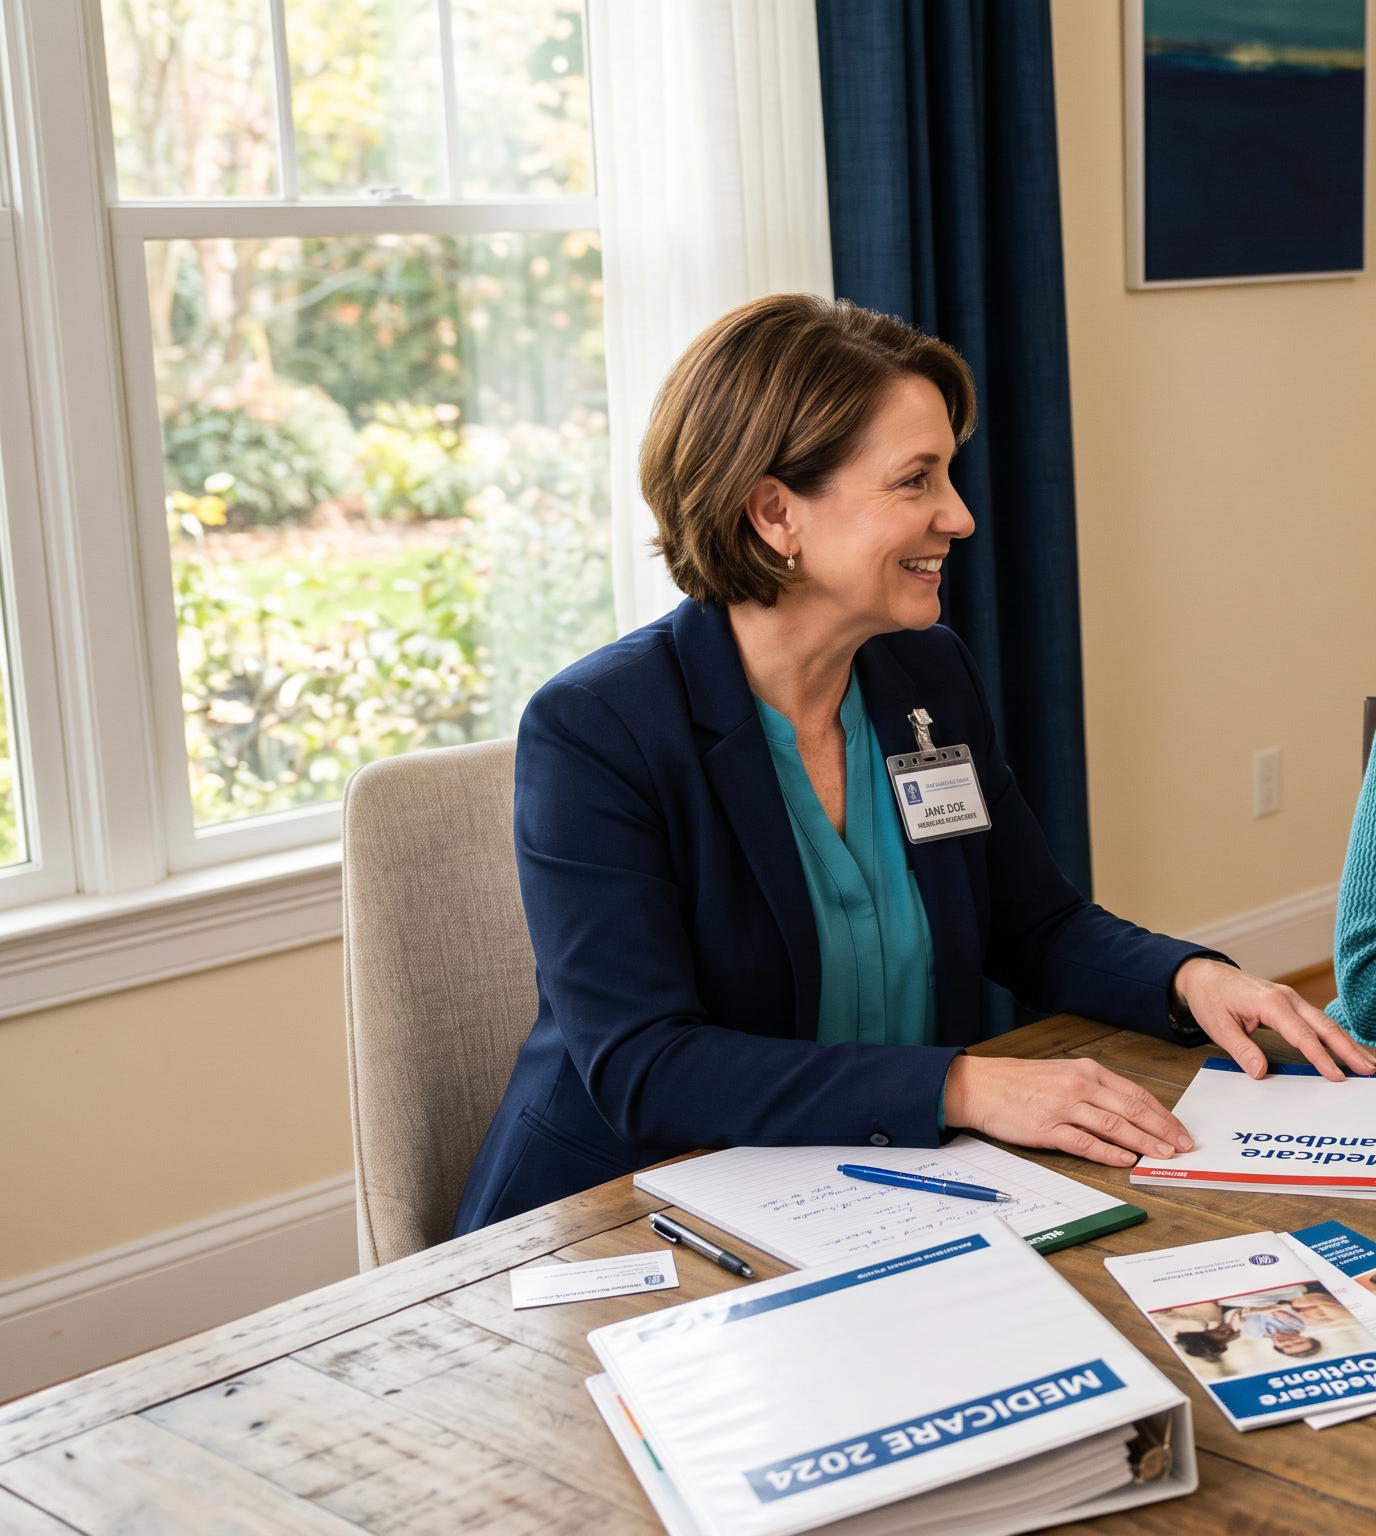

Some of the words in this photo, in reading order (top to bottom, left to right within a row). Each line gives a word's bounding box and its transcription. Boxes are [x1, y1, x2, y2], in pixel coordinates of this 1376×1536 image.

[925, 804, 946, 818] JANE
[947, 801, 965, 814] DOE
[881, 1369, 1103, 1455] MEDICARE
[764, 1441, 875, 1492] 2024
